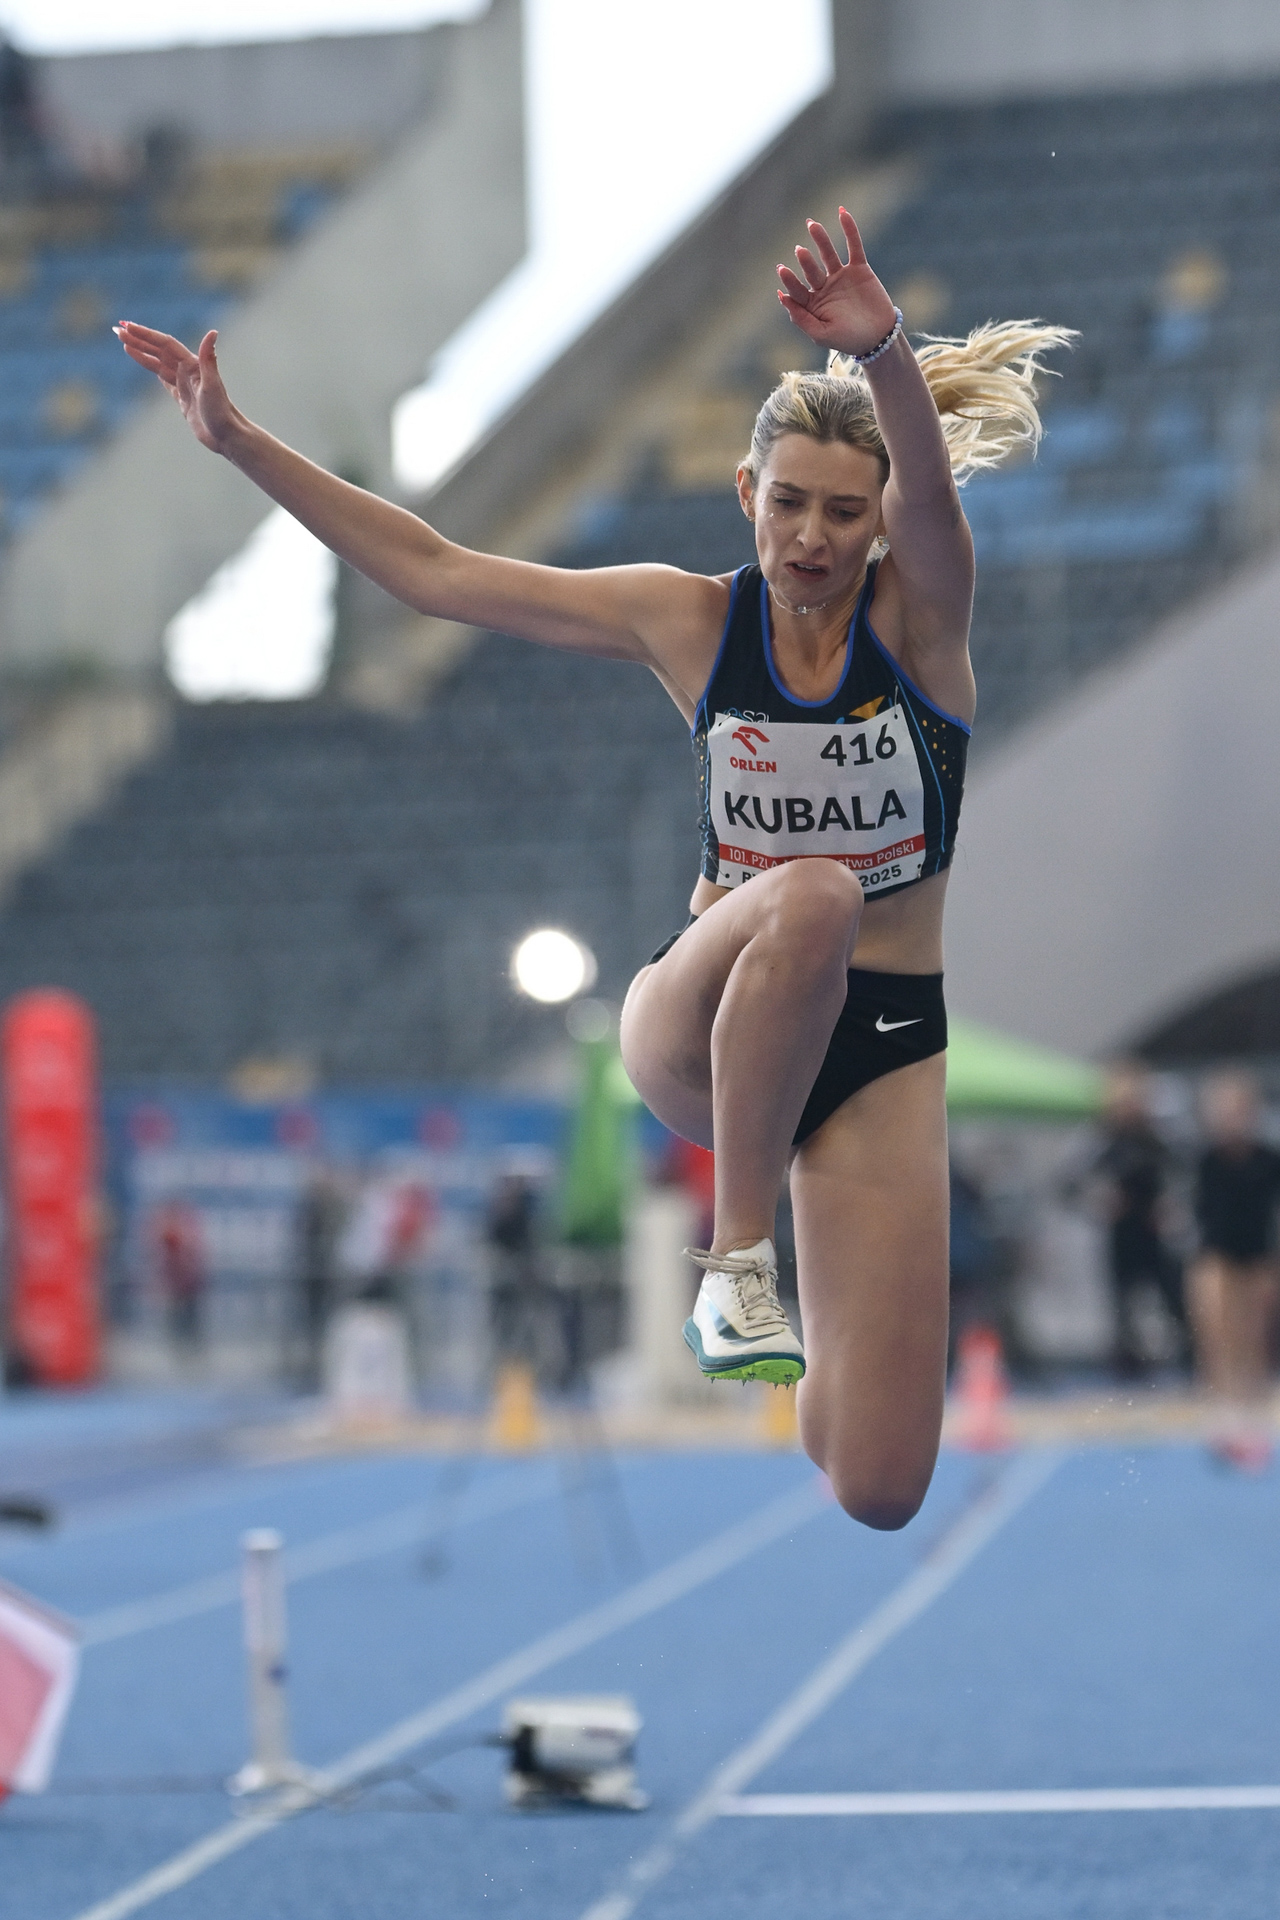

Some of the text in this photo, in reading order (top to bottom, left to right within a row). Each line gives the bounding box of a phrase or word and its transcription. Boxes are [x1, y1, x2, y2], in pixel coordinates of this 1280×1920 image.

[820, 723, 897, 767] 416
[730, 757, 777, 773] ORLEN
[724, 789, 907, 834] KUBALA
[729, 847, 749, 865] 101.
[752, 854, 778, 870] PZLA
[876, 840, 915, 863] Polski
[858, 864, 902, 888] 2025
